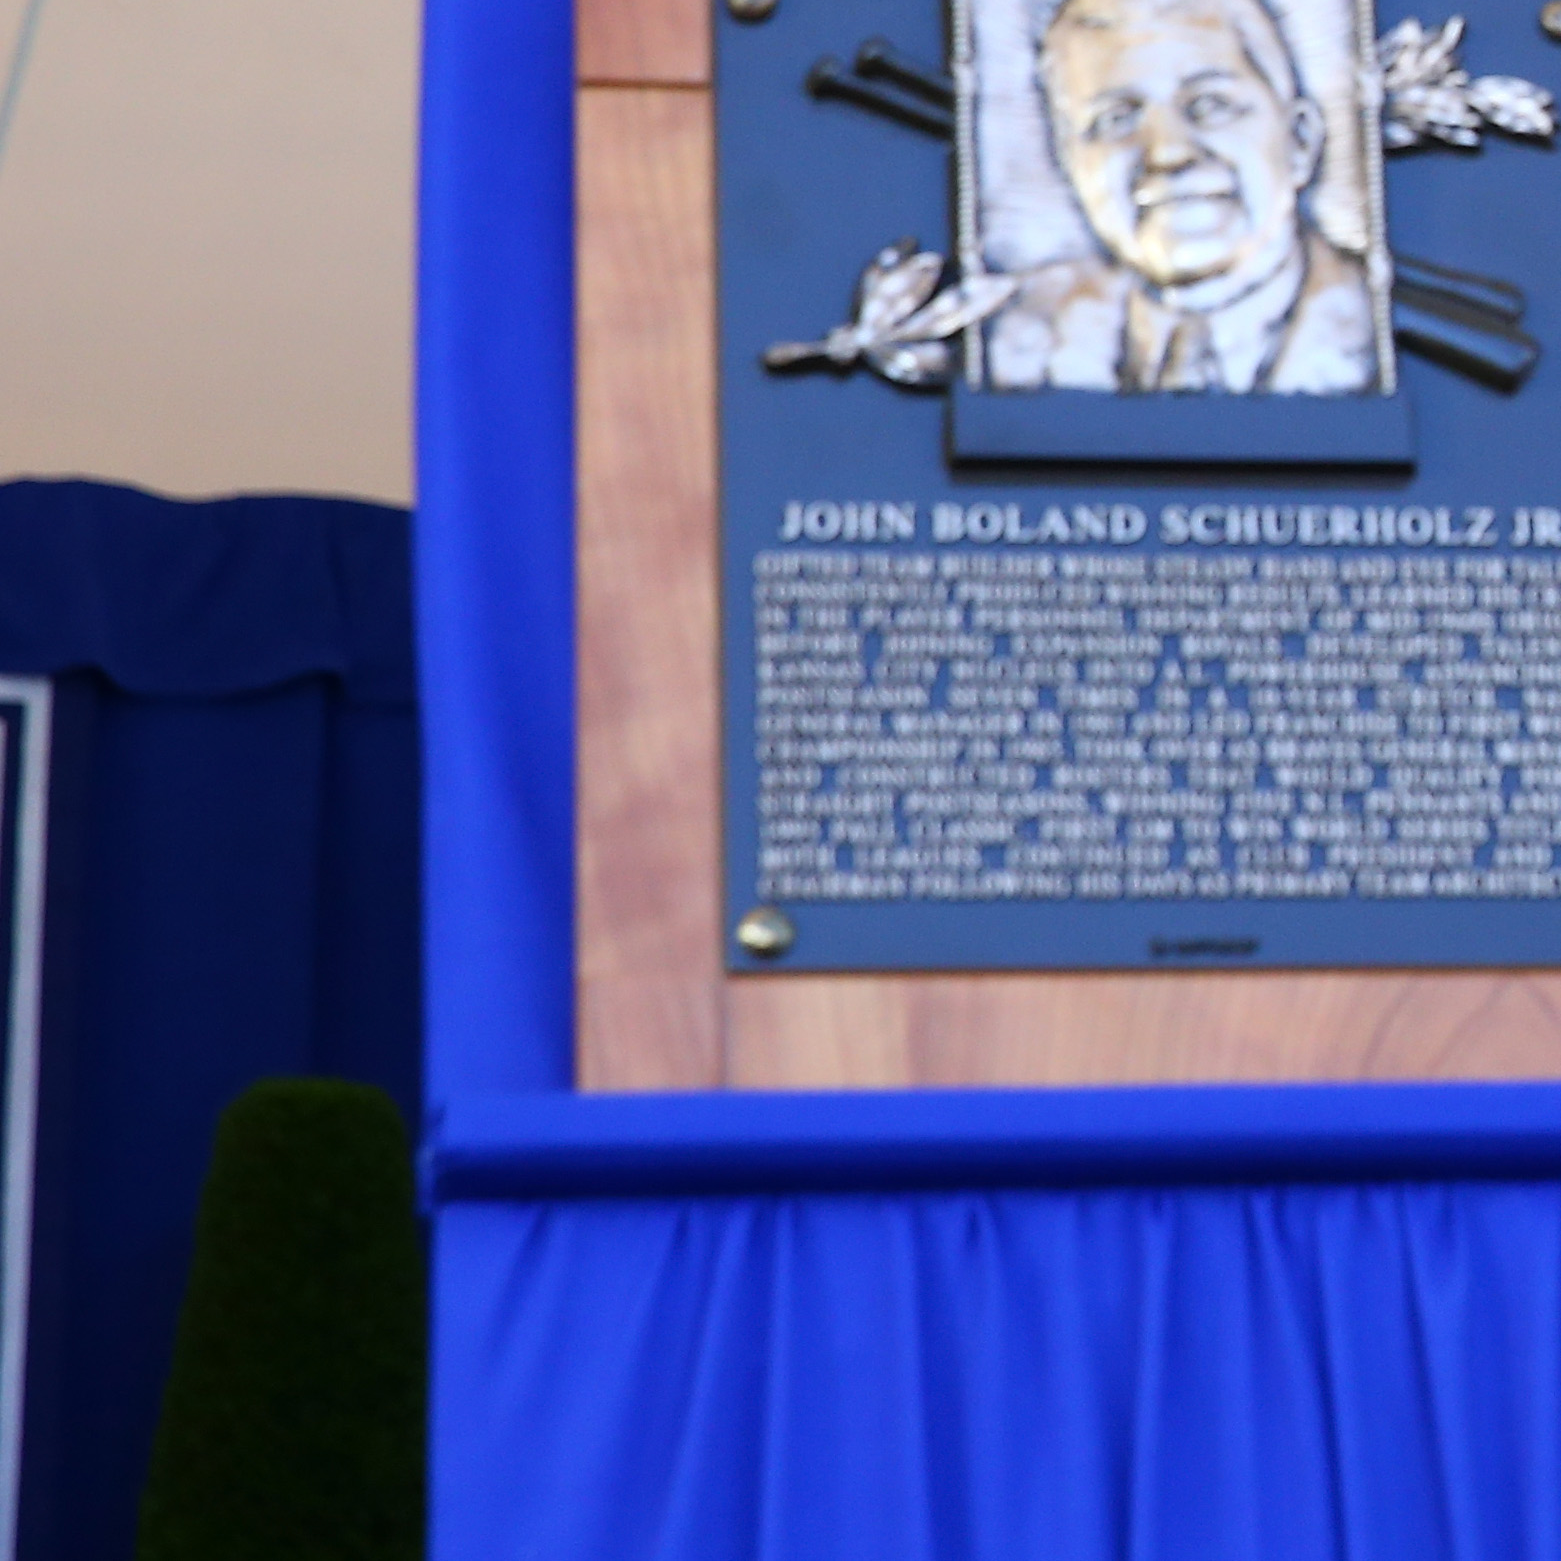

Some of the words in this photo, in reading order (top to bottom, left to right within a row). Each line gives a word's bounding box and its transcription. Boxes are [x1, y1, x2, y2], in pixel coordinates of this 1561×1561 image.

[778, 498, 917, 544] JOHN
[931, 500, 1148, 545] BOLAND
[1159, 502, 1498, 548] SCHUERHOLZ
